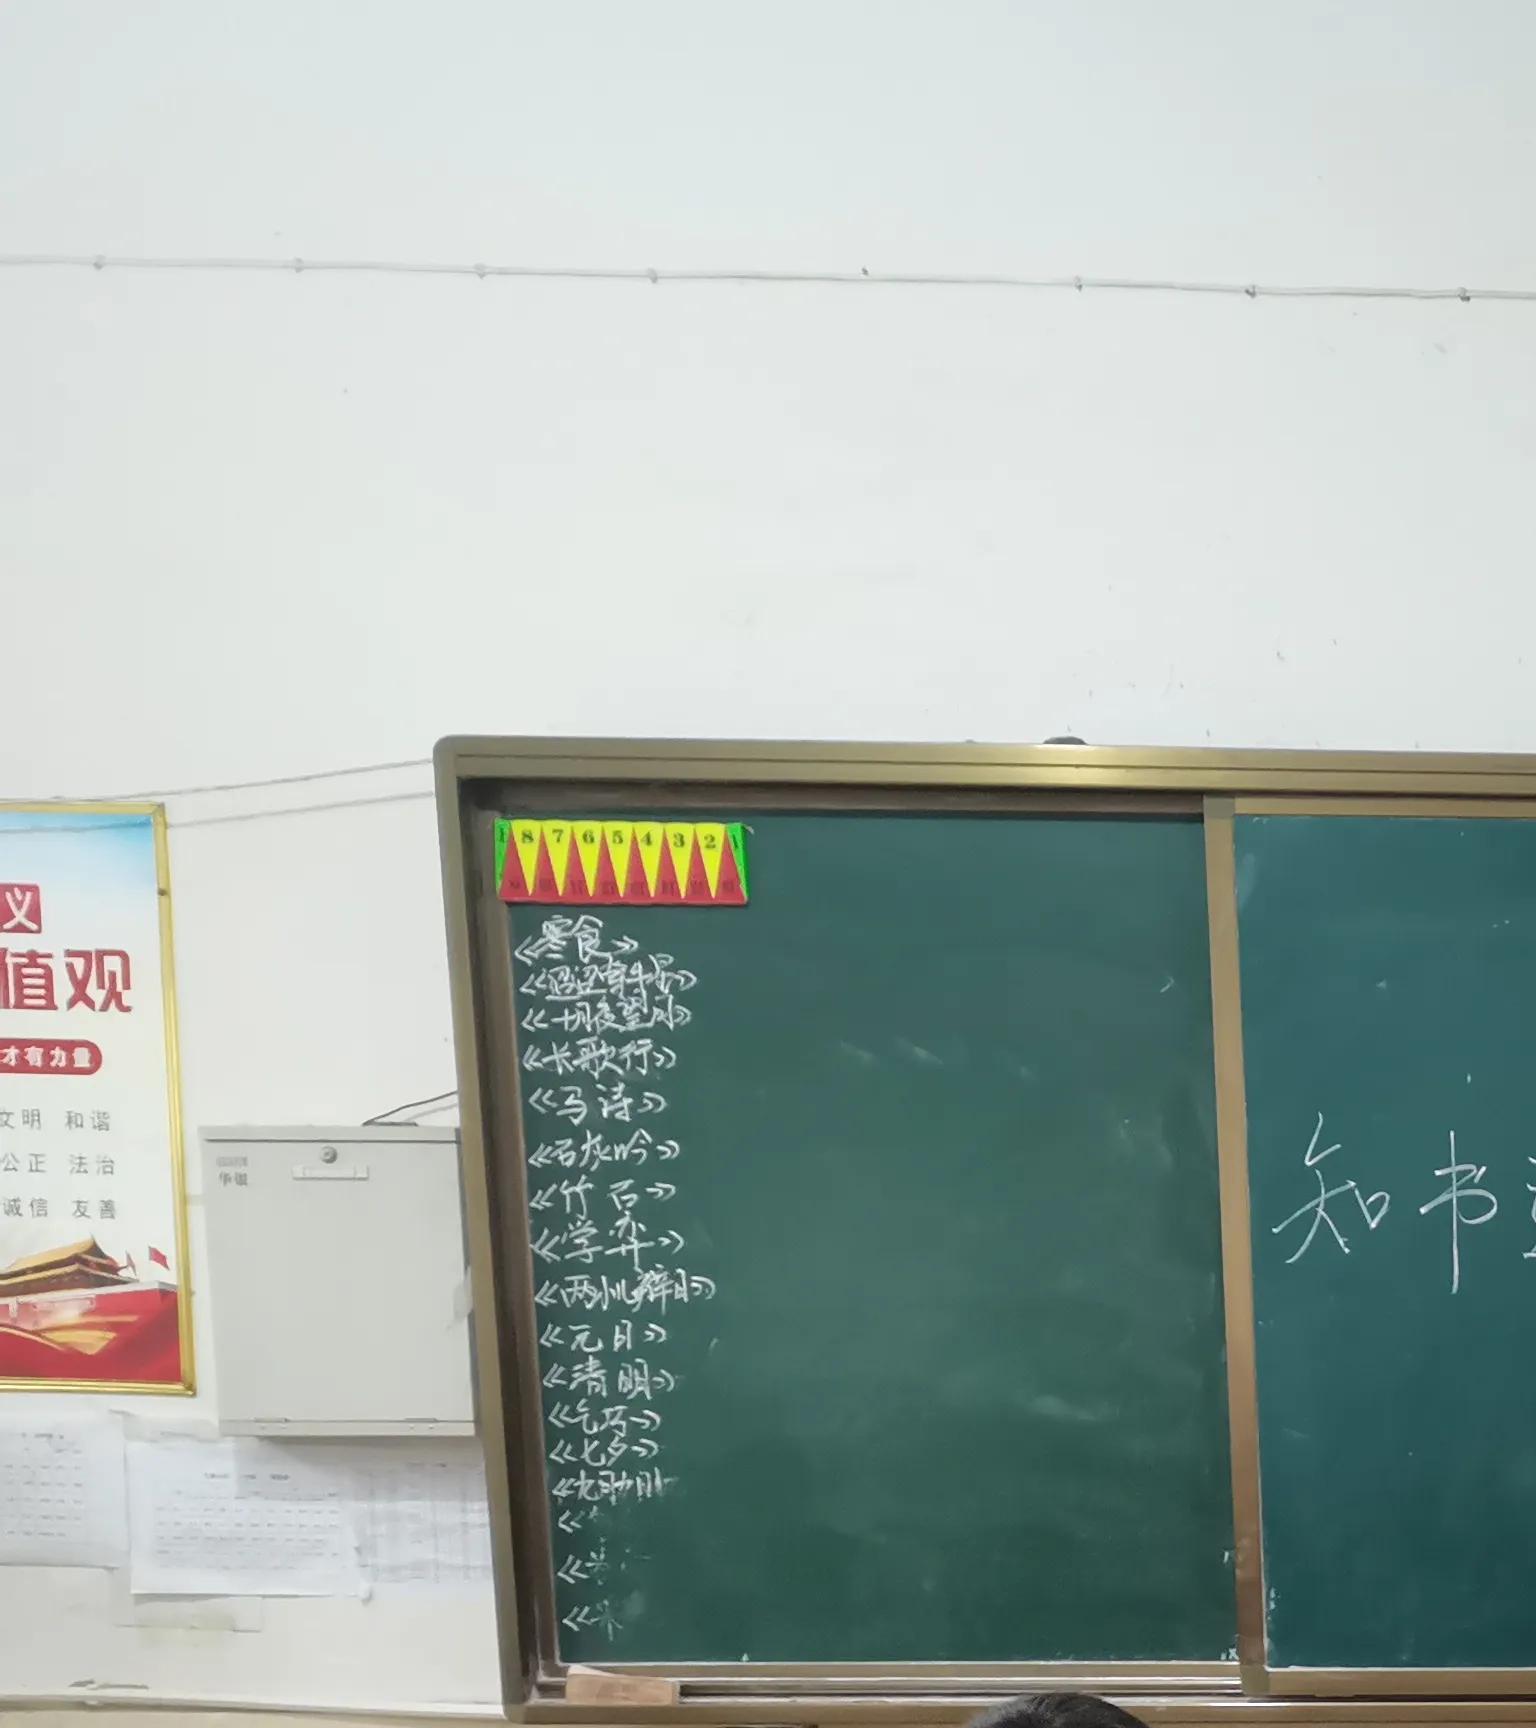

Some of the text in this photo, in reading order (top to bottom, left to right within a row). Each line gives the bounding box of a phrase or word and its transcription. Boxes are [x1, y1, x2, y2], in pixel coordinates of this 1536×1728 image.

[521, 829, 535, 843] 8
[552, 829, 564, 843] 7
[582, 829, 596, 845] 6
[611, 829, 624, 845] 5
[640, 831, 653, 846] 4
[672, 832, 685, 849] 3
[703, 834, 717, 849] 2
[2, 889, 39, 932] 义
[64, 1109, 111, 1132] 和谐
[1, 1152, 115, 1176] 公正 法治
[2, 1197, 116, 1220] 诚信 友善
